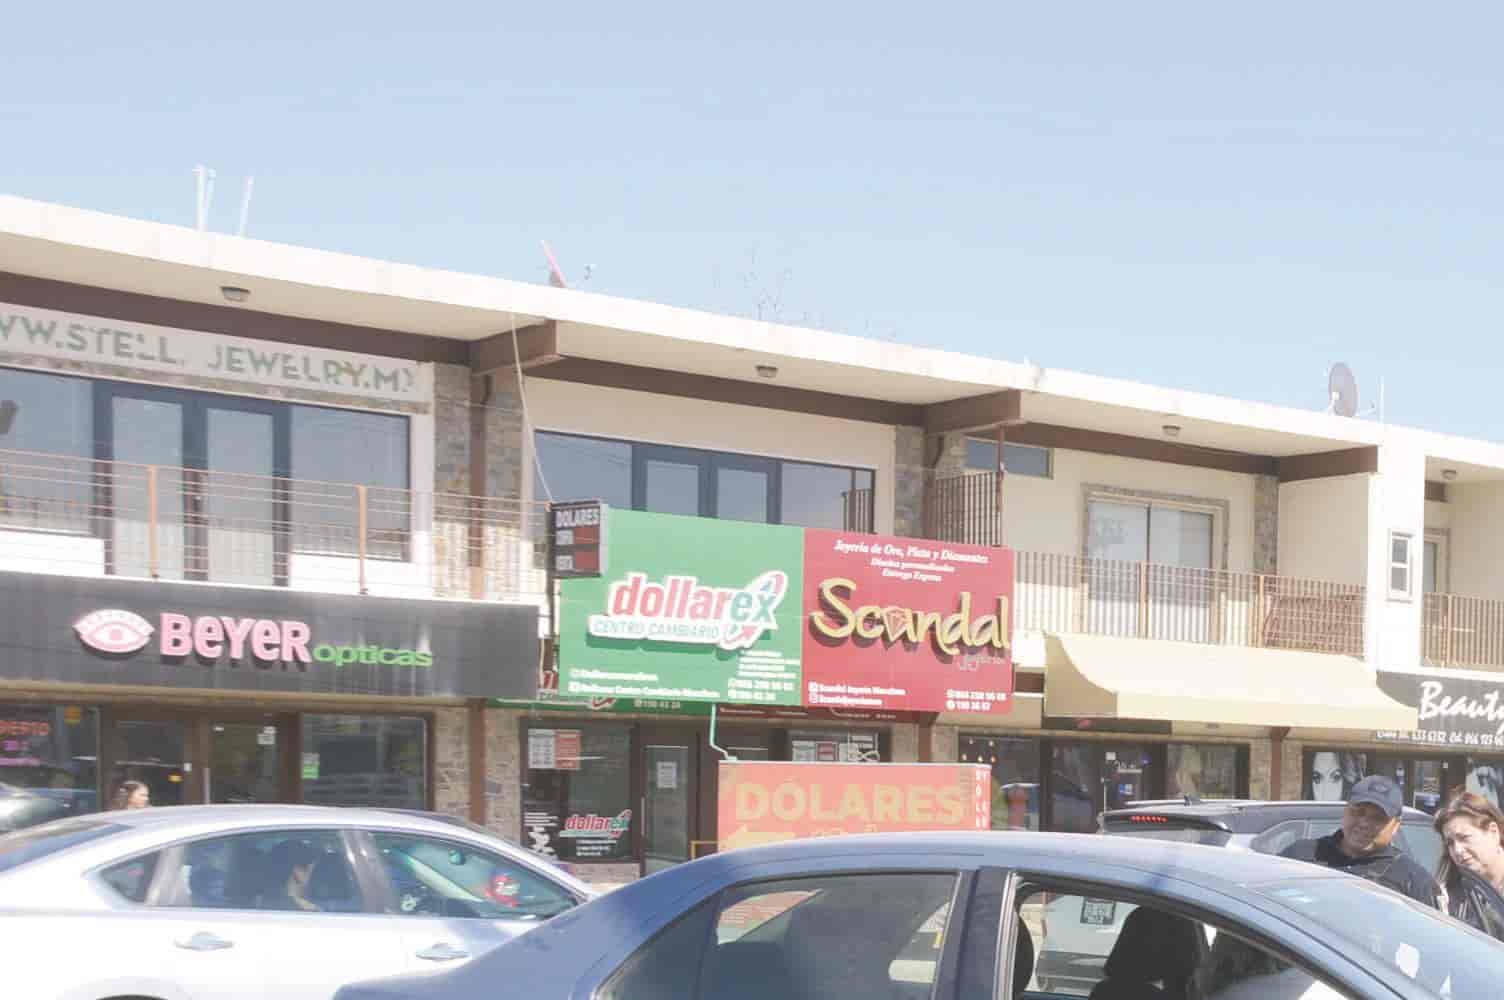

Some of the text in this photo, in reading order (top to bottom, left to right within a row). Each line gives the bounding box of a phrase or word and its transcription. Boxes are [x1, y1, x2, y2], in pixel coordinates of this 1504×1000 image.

[612, 574, 778, 624] dollarex
[809, 578, 1010, 656] Scandal
[592, 619, 720, 640] CENTRO CAMBIARIO
